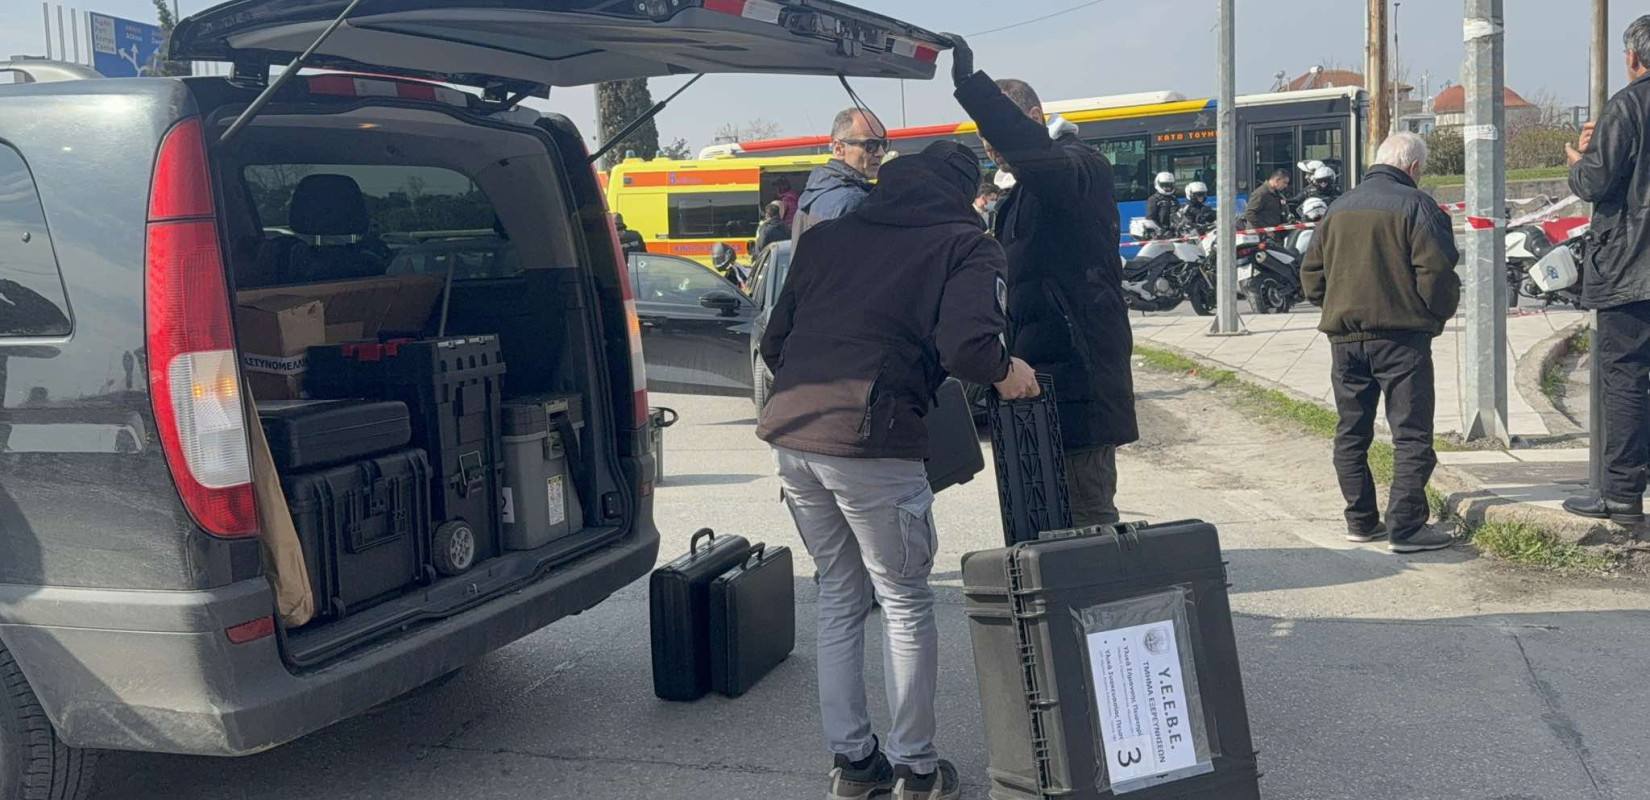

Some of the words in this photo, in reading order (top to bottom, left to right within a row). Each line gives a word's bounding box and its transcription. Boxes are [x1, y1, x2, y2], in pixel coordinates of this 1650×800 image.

[1143, 661, 1153, 695] ΤΜΗΜΑ
[1149, 697, 1165, 763] ΕΞΕΡΕΥΝΗΣΕΩΝ
[1158, 667, 1182, 749] Υ.Ε.Ε.Β.Ε.
[1117, 748, 1142, 767] 3
